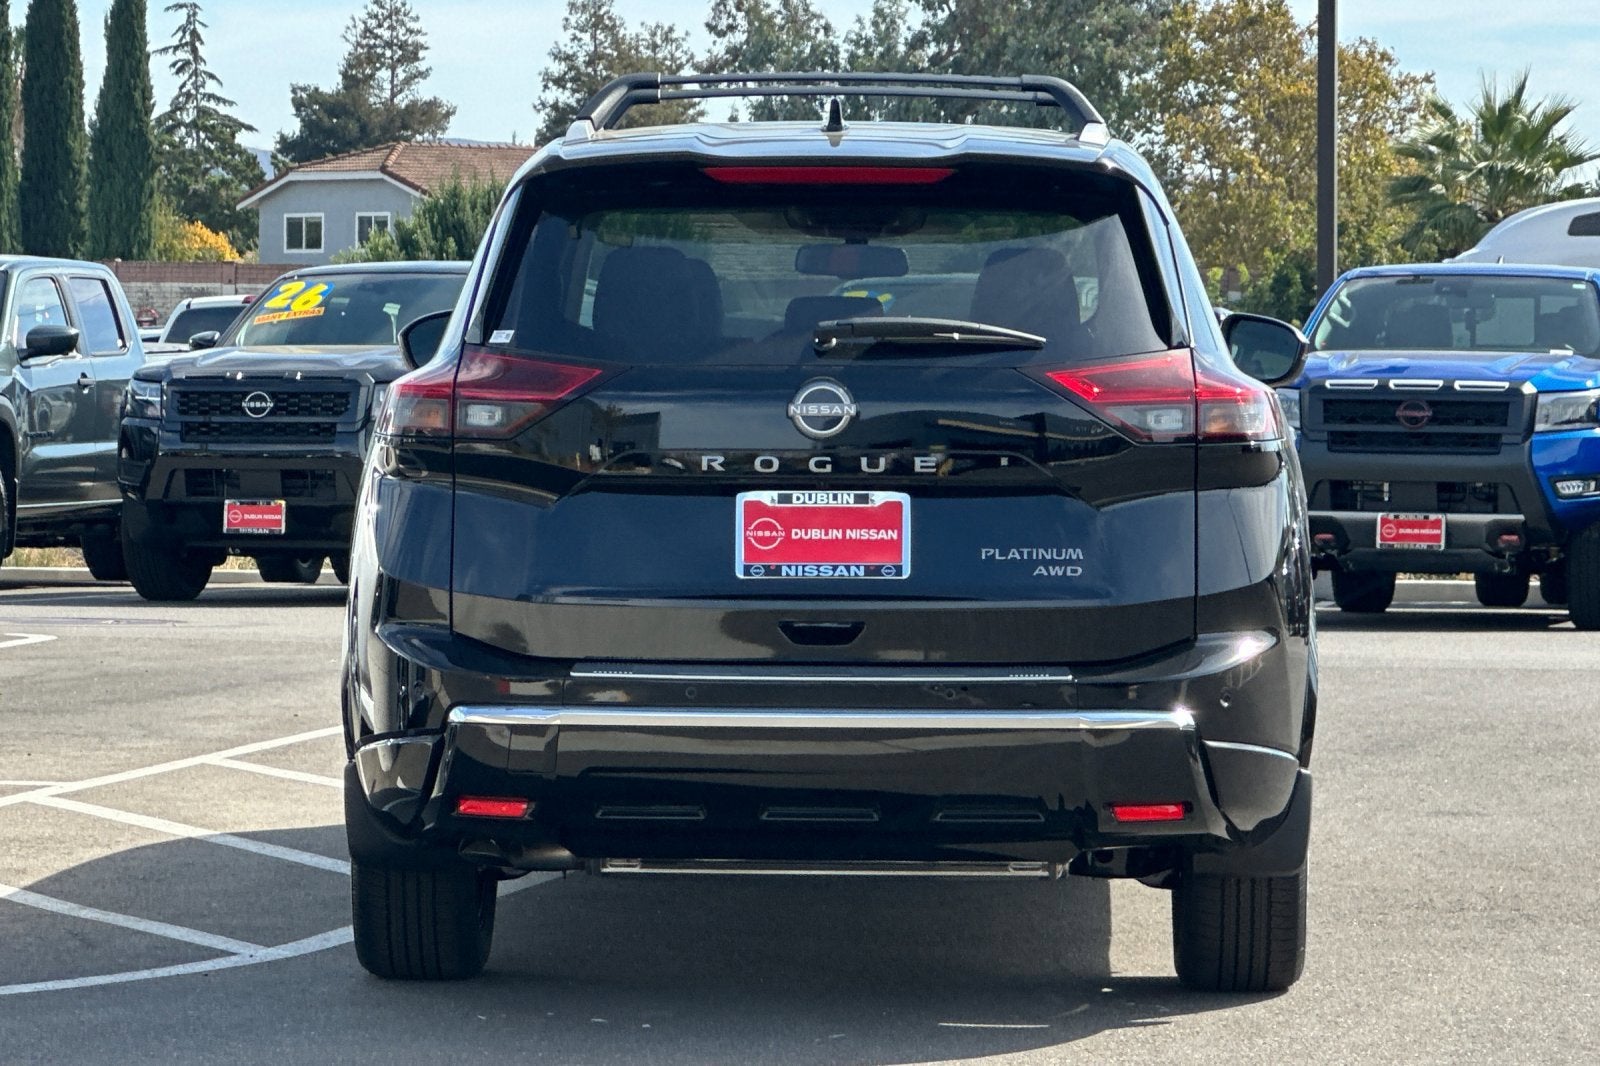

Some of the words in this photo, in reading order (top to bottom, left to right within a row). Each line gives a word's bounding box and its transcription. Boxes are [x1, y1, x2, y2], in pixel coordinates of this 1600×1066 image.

[264, 281, 329, 312] 26
[285, 307, 322, 319] EXTRAS
[790, 405, 855, 414] NISSAN
[701, 455, 937, 473] ROGUE
[792, 493, 854, 504] DUBLIN
[791, 529, 842, 540] DUBLIN
[845, 529, 898, 540] NISSAN
[981, 548, 1084, 560] PLATINUM
[781, 565, 865, 576] NISSAN
[1033, 565, 1083, 576] AWD
